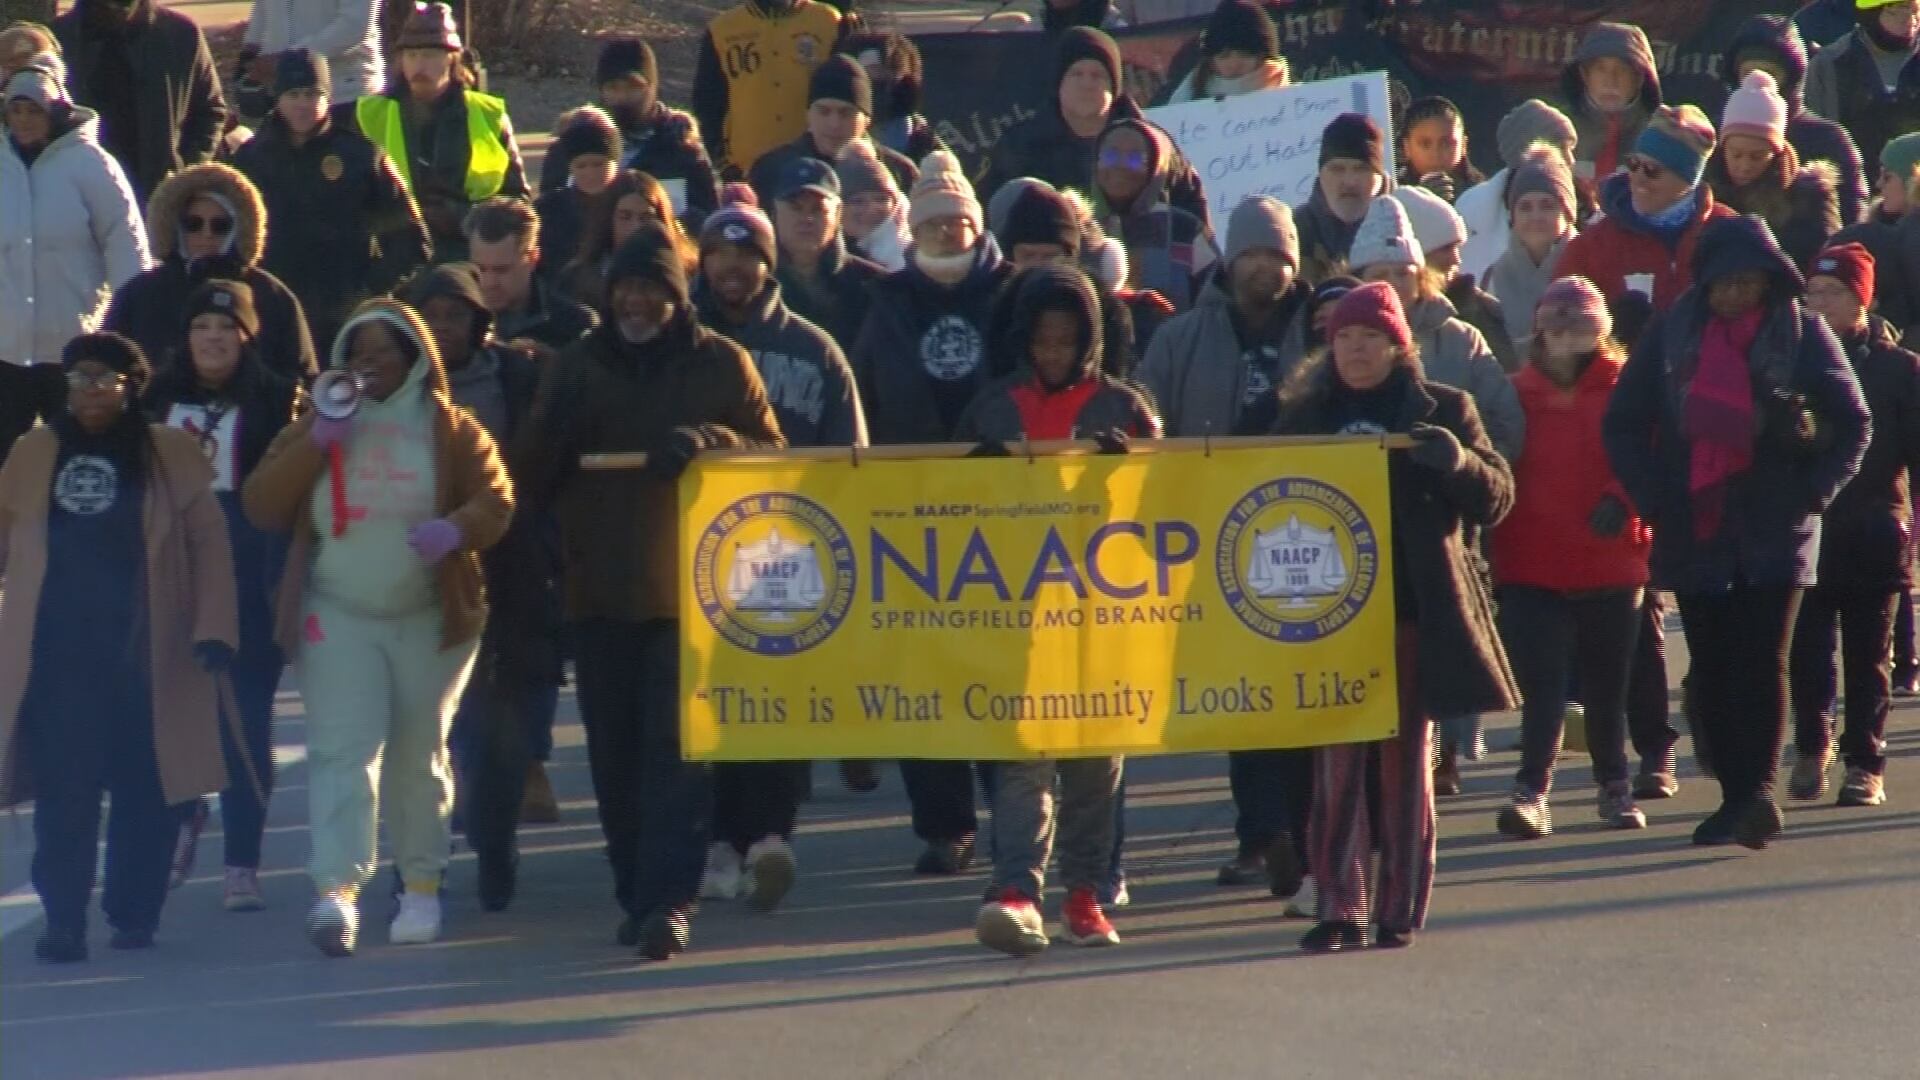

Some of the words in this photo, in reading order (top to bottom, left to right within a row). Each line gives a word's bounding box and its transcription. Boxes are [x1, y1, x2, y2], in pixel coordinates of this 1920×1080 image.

[870, 520, 1201, 603] NAACP
[1270, 547, 1321, 566] NAACP
[750, 561, 801, 579] NAACP
[1095, 604, 1204, 626] BRANCH
[808, 684, 835, 725] is
[856, 683, 944, 722] What
[963, 679, 1154, 725] Community
[1175, 676, 1274, 715] Looks
